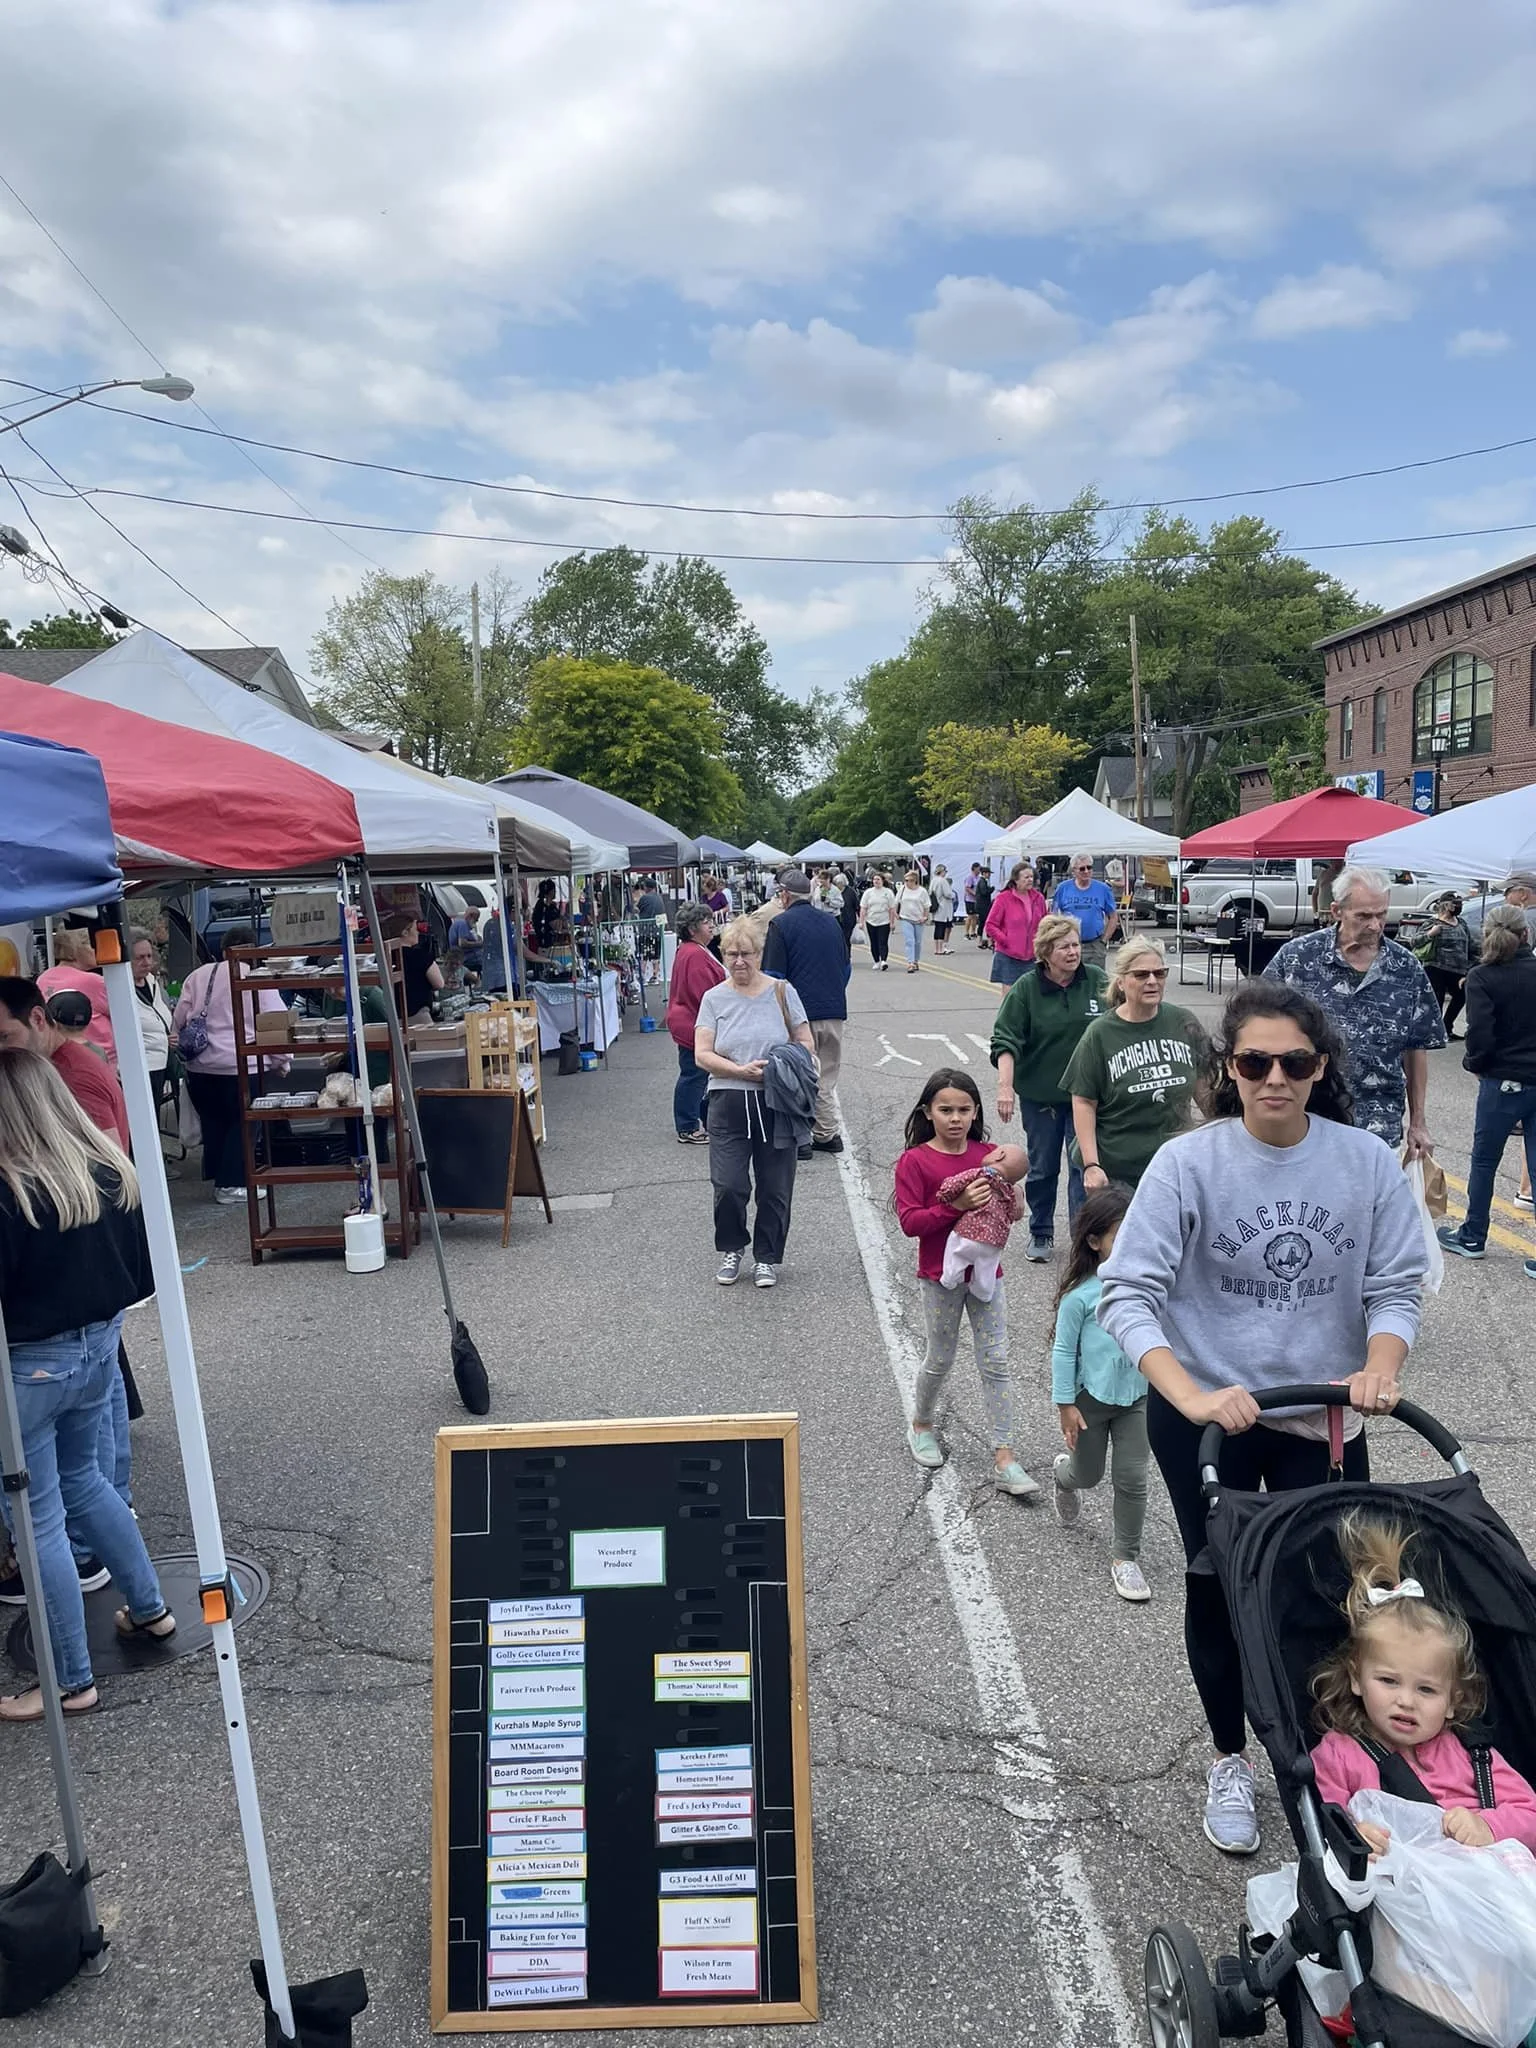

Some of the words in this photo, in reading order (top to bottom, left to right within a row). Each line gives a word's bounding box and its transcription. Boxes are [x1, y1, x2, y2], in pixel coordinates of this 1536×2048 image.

[1108, 1039, 1160, 1082] MICHIGAN
[1160, 1039, 1193, 1068] STATE
[1130, 1077, 1184, 1092] SPARTANS
[1211, 1201, 1355, 1259] MACKINAC
[1221, 1275, 1291, 1301] BRIDGE
[604, 1560, 632, 1568] Produce
[500, 1605, 522, 1615] Joyful
[524, 1604, 544, 1612] Paws
[546, 1602, 572, 1612] Bakery
[504, 1628, 540, 1637] Hiawatha
[496, 1651, 516, 1660] Golly
[535, 1649, 561, 1658] Gluten
[546, 1684, 576, 1692] Produce
[495, 1721, 530, 1730] Kurzhals
[532, 1720, 555, 1728] Maple
[558, 1720, 581, 1728] Syrup
[510, 1742, 564, 1750] MMMacarons
[495, 1768, 519, 1777] Board
[521, 1767, 544, 1775] Room
[546, 1766, 579, 1775] Designs
[544, 1788, 566, 1796] People
[668, 1802, 689, 1810] Fred's
[691, 1802, 710, 1811] Jerky
[712, 1801, 741, 1809] Product
[509, 1816, 532, 1824] Circle
[542, 1814, 566, 1822] Ranch
[671, 1826, 693, 1834] Glitter
[702, 1824, 726, 1832] Gleam
[496, 1863, 525, 1872] Alicia's
[528, 1861, 561, 1870] Mexican
[563, 1860, 579, 1868] Deli
[669, 1876, 680, 1884] G3
[683, 1876, 702, 1884] Food
[544, 1888, 570, 1896] Greens
[520, 1912, 538, 1920] Jams
[540, 1911, 554, 1919] and
[556, 1911, 579, 1919] Jellies
[500, 1933, 528, 1942] Baking
[561, 1932, 577, 1940] You
[529, 1958, 549, 1966] DDA
[686, 1973, 707, 1981] Fresh
[494, 1989, 522, 1998] DeWitt
[525, 1986, 549, 1995] Public
[551, 1984, 579, 1993] Library
